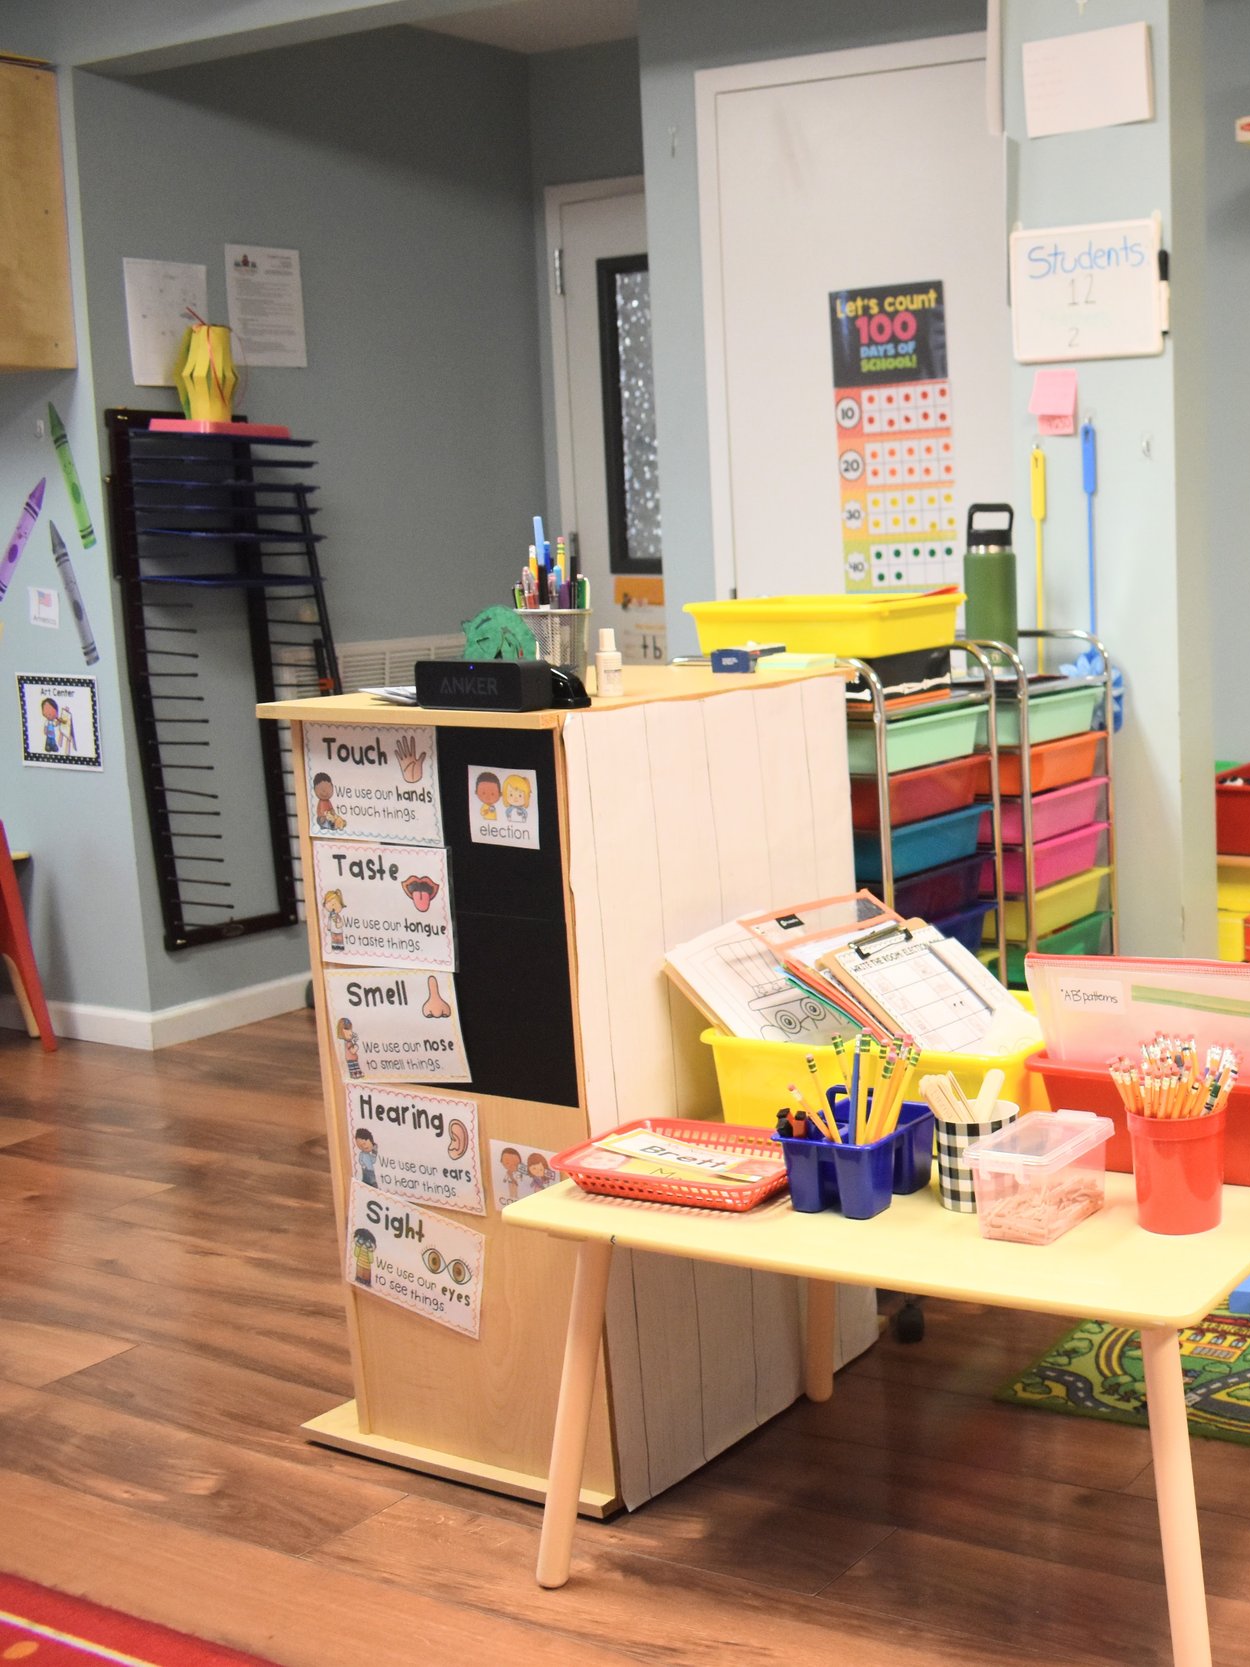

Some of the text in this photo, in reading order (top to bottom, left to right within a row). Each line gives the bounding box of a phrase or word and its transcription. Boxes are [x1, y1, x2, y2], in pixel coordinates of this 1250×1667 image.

[1027, 235, 1146, 279] Students
[1067, 273, 1096, 306] 12
[836, 288, 938, 319] Let's count
[854, 310, 918, 344] 100
[1068, 327, 1080, 348] 2
[860, 340, 917, 359] DAYS OF
[861, 354, 918, 373] SCHOOL!
[841, 407, 855, 421] 10
[842, 459, 861, 474] 20
[845, 508, 862, 522] 30
[848, 561, 865, 574] 40
[53, 687, 75, 698] Center
[440, 677, 498, 695] ANKER
[322, 736, 388, 766] Touch
[335, 785, 433, 803] We use our hands
[336, 803, 348, 816] to
[350, 804, 381, 818] touch
[480, 823, 531, 841] election
[332, 854, 399, 881] Taste
[343, 915, 447, 937] We use our tongue
[345, 934, 356, 945] to
[358, 935, 385, 949] taste
[346, 979, 409, 1008] Smell
[1082, 990, 1119, 1004] patterns
[362, 1039, 455, 1053] We use our nose
[366, 1058, 378, 1071] to
[380, 1058, 406, 1070] smell
[360, 1094, 445, 1138] Hearing
[640, 1145, 727, 1169] Brett
[378, 1155, 472, 1183] We use our ears
[380, 1173, 392, 1185] to
[394, 1175, 420, 1189] hear
[366, 1200, 425, 1243] Sight
[375, 1255, 471, 1307] We use our eyes
[375, 1274, 387, 1286] to
[389, 1279, 408, 1296] see
